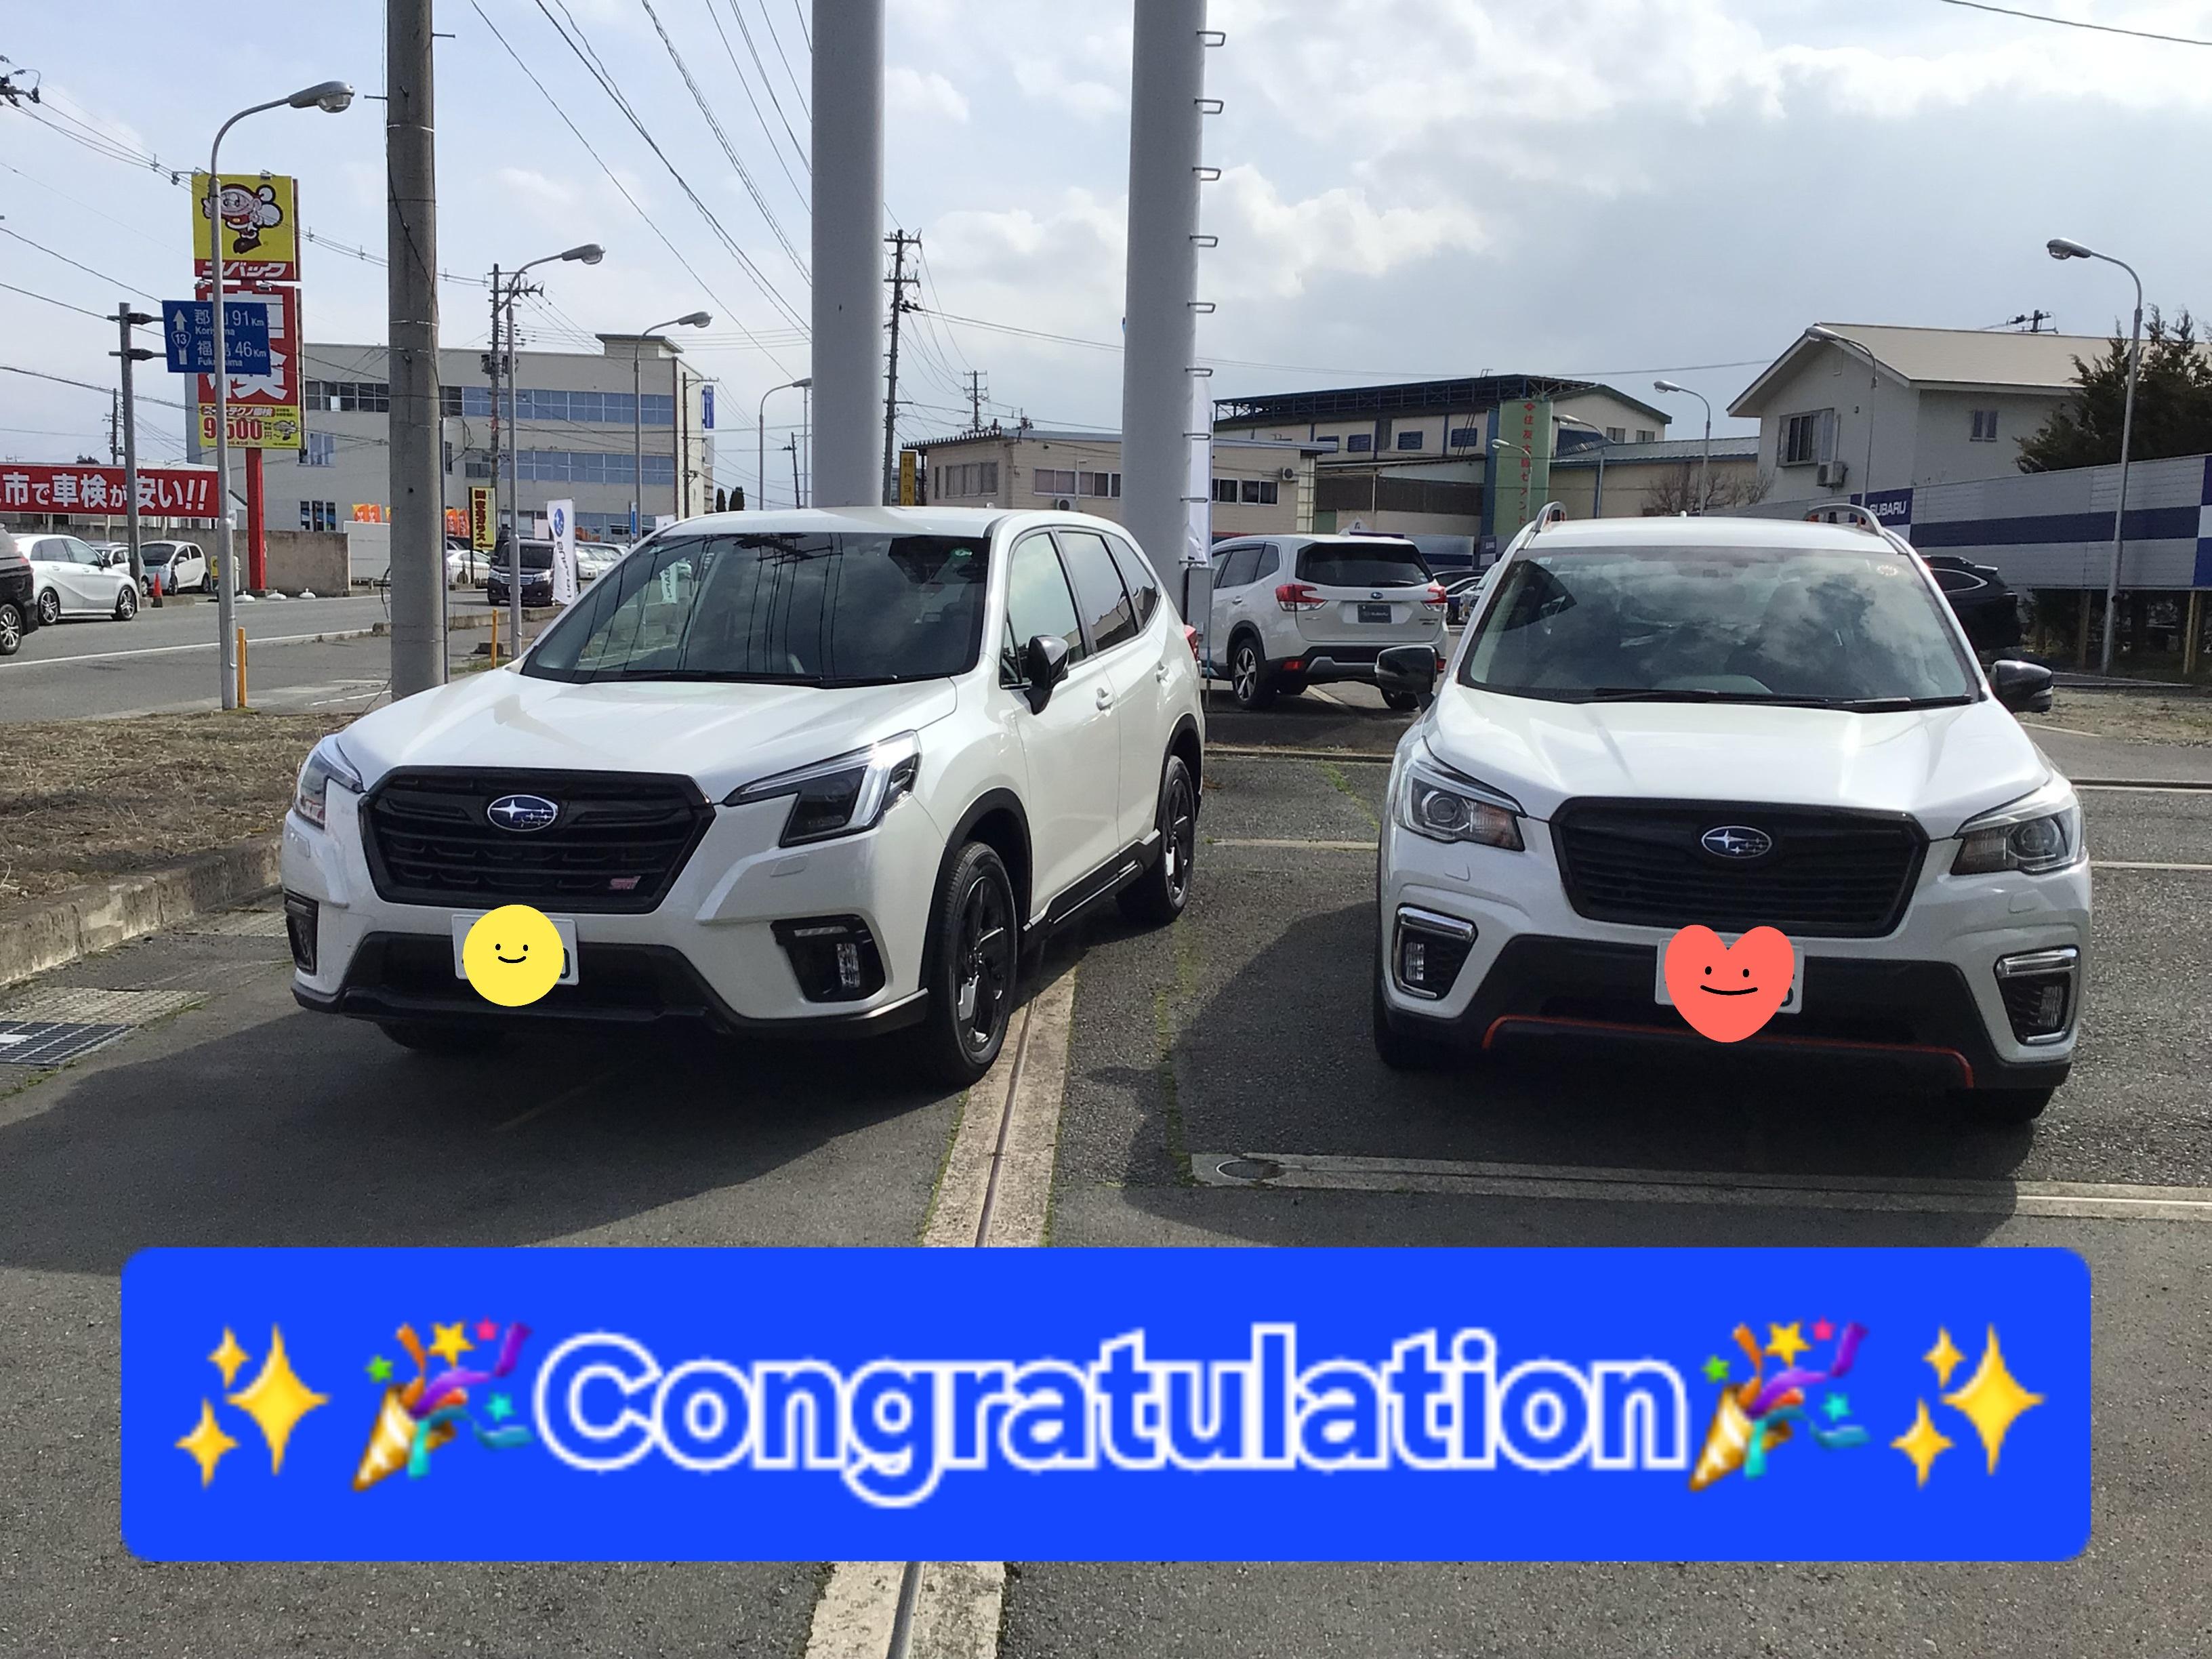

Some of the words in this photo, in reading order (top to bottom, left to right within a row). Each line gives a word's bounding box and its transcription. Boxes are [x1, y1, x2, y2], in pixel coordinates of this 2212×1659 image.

[194, 309, 228, 326] 郡
[174, 333, 187, 345] 13
[0, 472, 207, 510] 市で車検が安い!!
[1869, 501, 1907, 516] SUBARU
